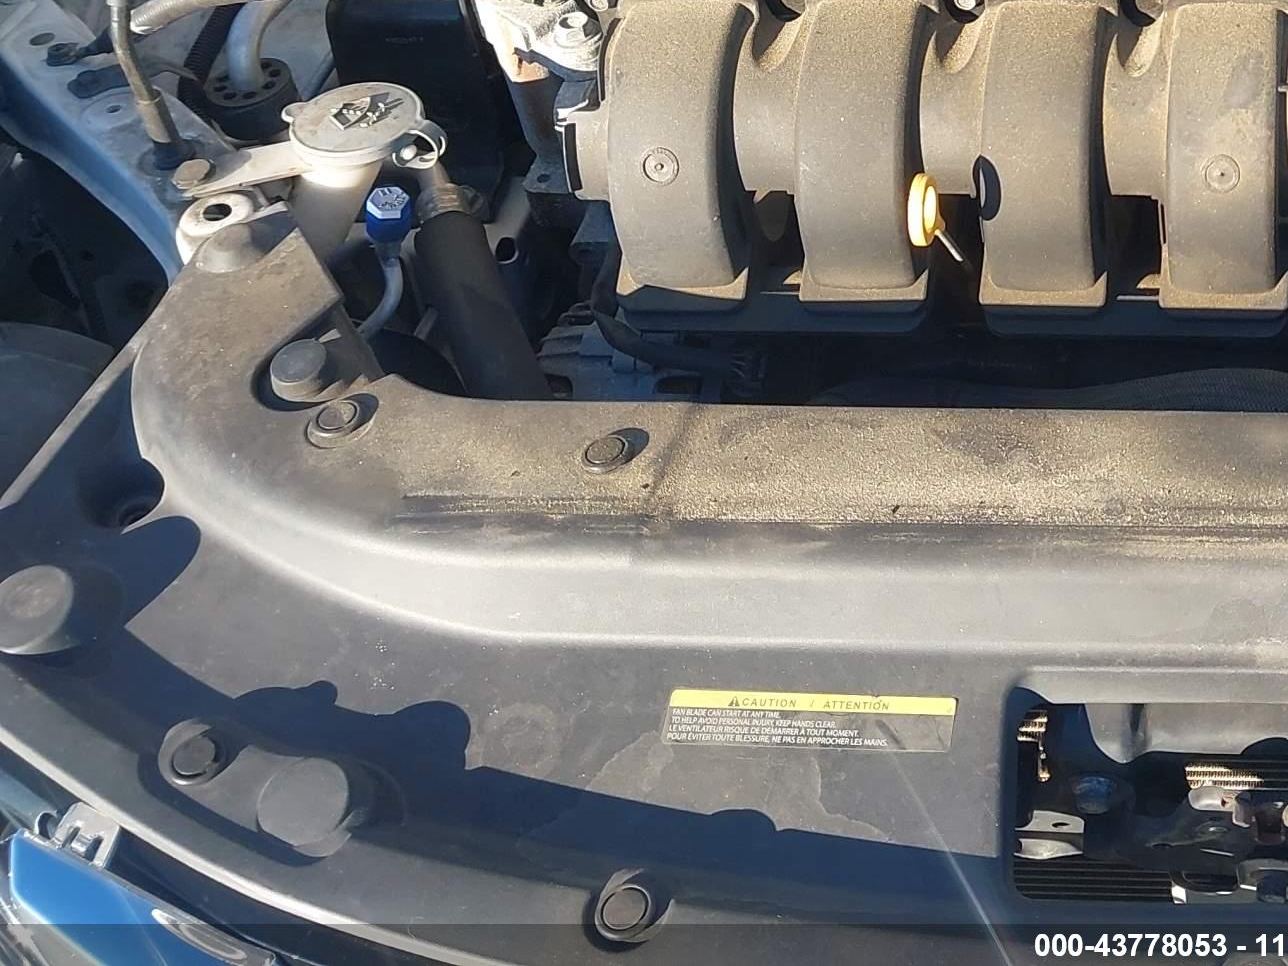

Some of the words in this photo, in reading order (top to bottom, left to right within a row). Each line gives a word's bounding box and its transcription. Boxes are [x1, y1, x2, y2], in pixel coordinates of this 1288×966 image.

[742, 697, 797, 707] CAUTION
[823, 699, 890, 711] ATTENTION
[672, 708, 686, 716] FAN
[686, 708, 706, 716] BLADE
[721, 709, 741, 717] START
[719, 718, 750, 726] PERSONAL
[775, 719, 791, 727] KEEP
[678, 725, 723, 733] VENTILATEUR
[724, 725, 749, 734] RISQUE
[667, 732, 688, 740] POUR
[712, 733, 735, 741] TOUTE
[807, 737, 850, 745] APPROCHER
[850, 738, 863, 746] LES
